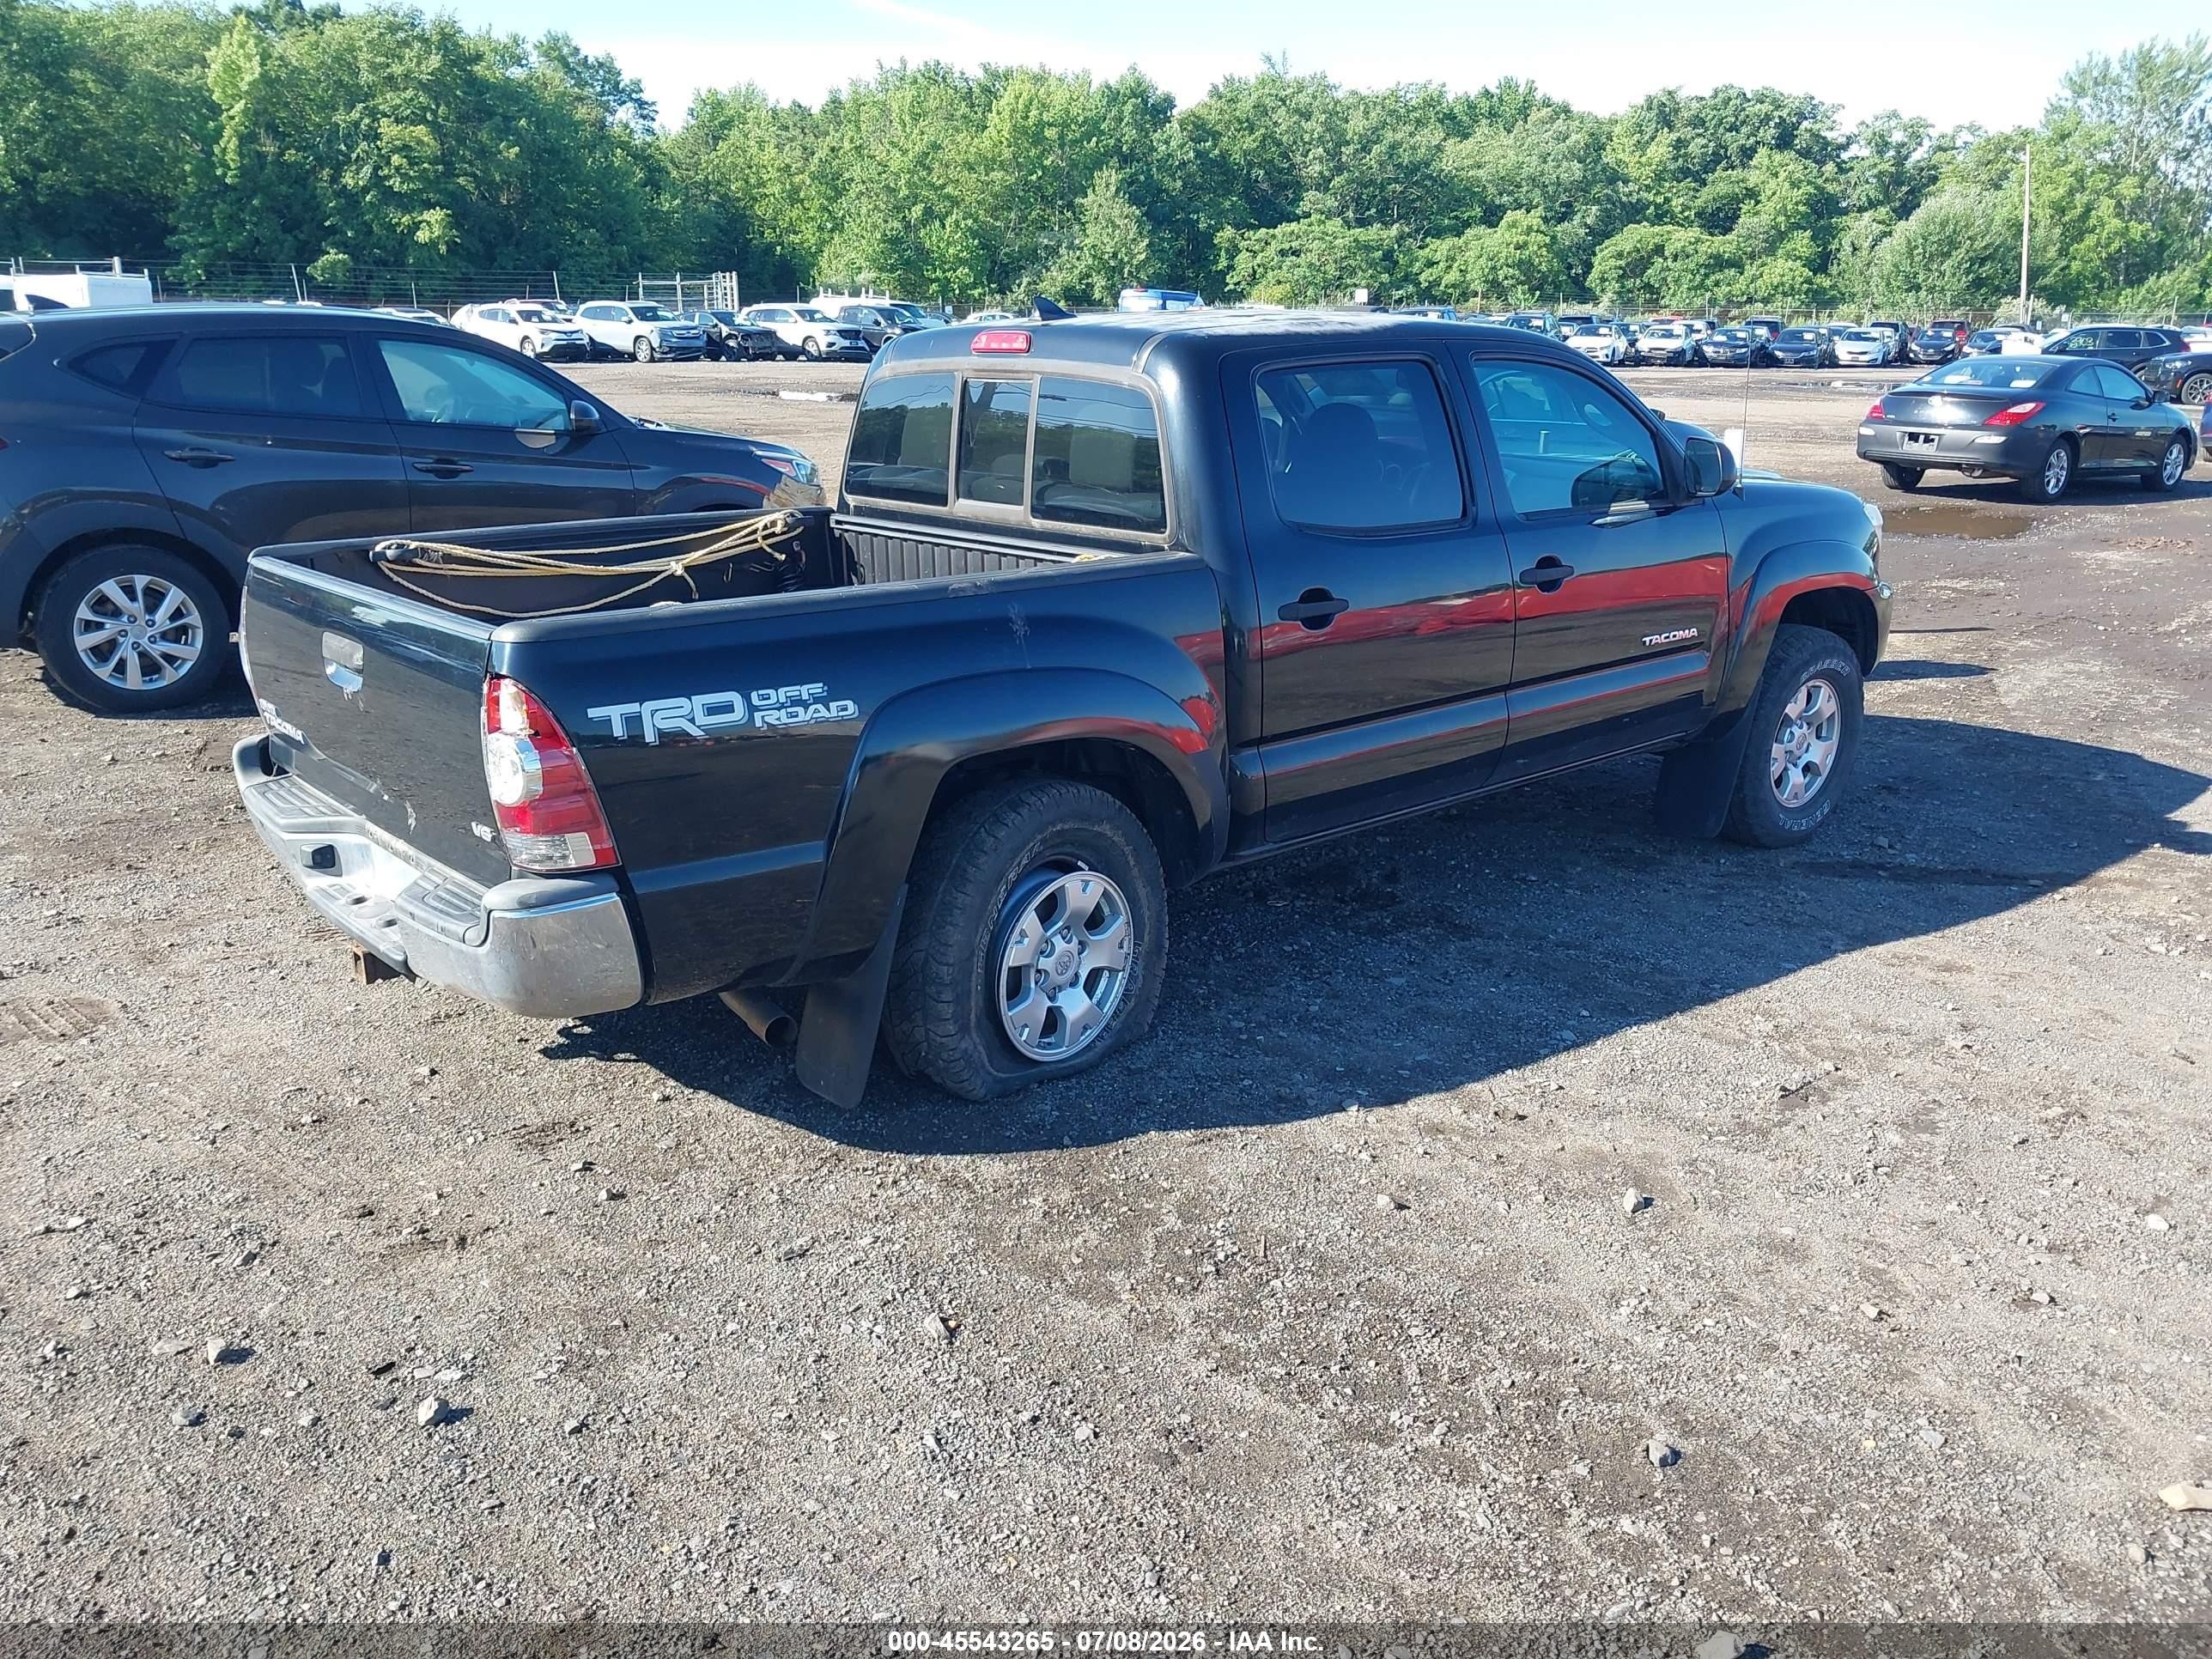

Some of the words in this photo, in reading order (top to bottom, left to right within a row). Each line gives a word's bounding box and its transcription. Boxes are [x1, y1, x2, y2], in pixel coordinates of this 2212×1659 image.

[1642, 628, 1698, 646] TACOMA
[263, 711, 305, 745] TACOMA
[587, 691, 747, 745] TRD
[750, 683, 828, 708] OFF
[754, 700, 858, 730] ROAD
[471, 821, 495, 842] V6
